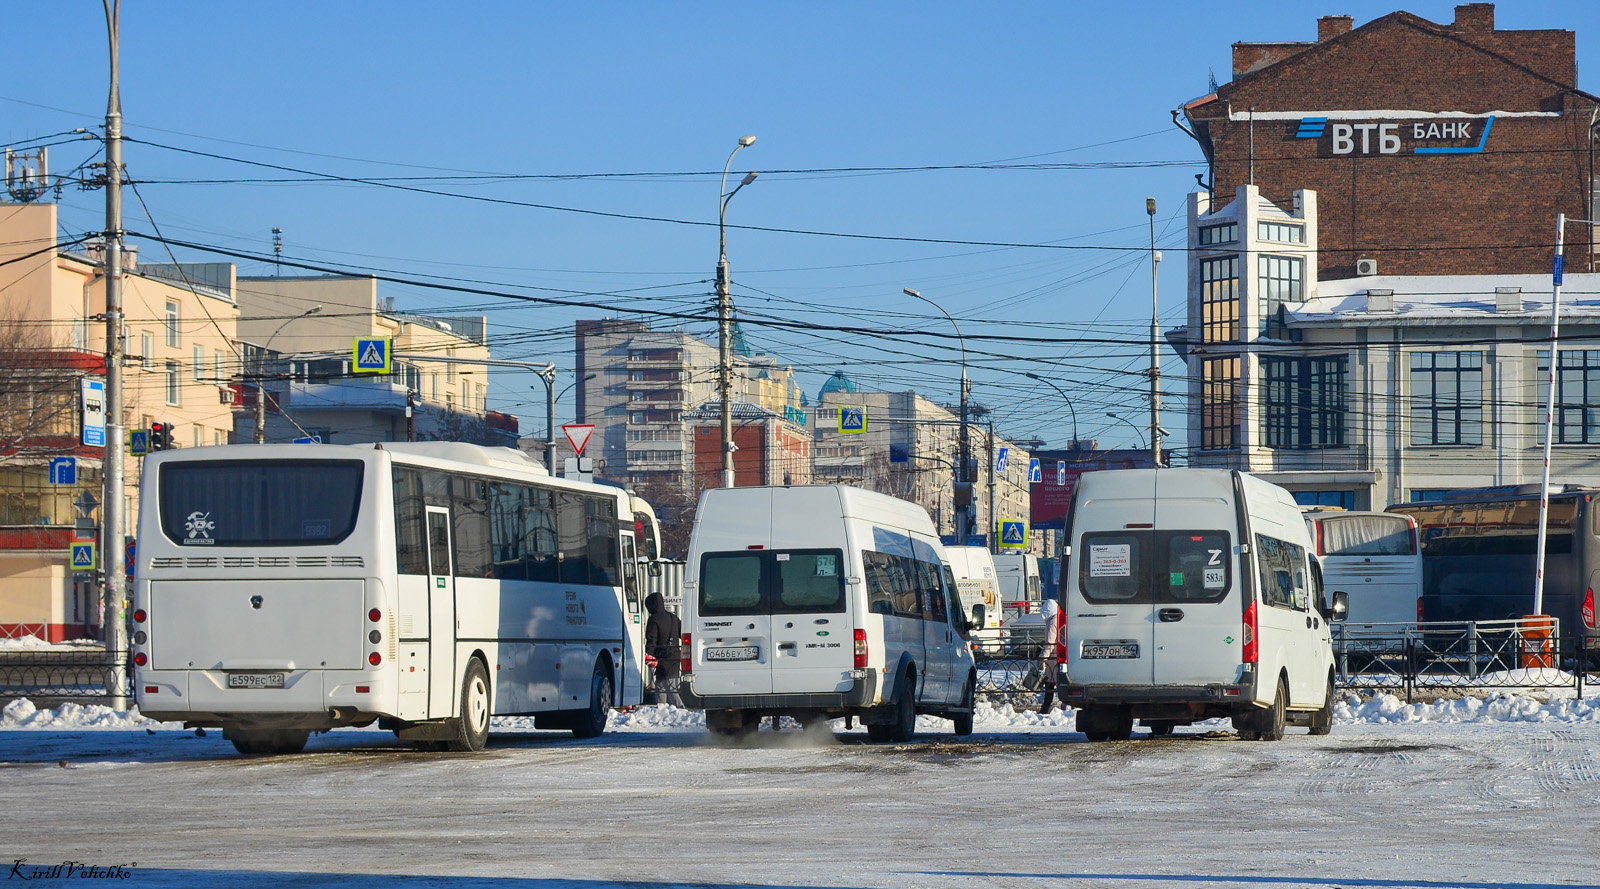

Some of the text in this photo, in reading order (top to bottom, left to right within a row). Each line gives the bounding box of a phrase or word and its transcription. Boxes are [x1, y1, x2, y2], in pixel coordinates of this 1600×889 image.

[1332, 122, 1471, 155] ВТБ БАНК
[817, 556, 834, 567] 576
[1207, 549, 1222, 566] Z
[268, 674, 282, 683] 122
